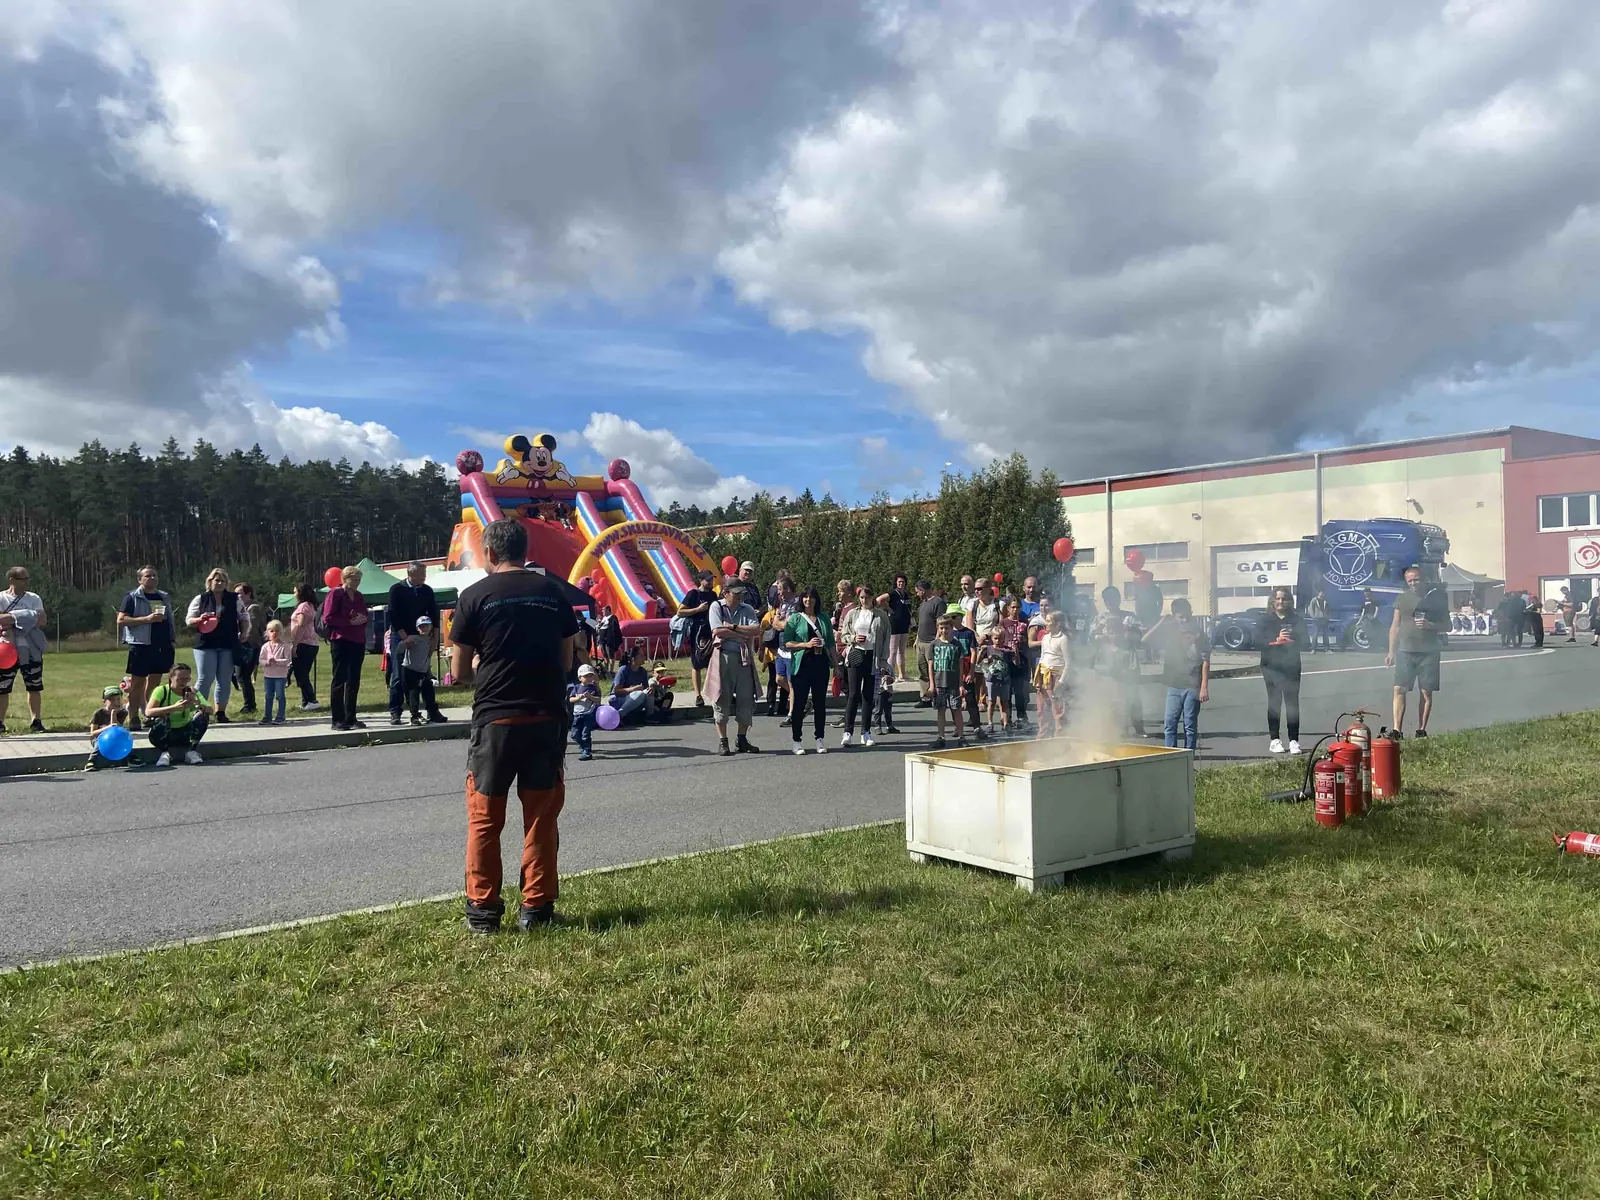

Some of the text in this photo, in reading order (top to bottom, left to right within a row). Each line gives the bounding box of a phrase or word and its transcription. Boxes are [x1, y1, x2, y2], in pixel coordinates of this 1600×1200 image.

[1323, 532, 1374, 555] ARGMAN
[1237, 560, 1289, 573] GATE
[1256, 574, 1269, 584] 6
[933, 645, 960, 660] STAY
